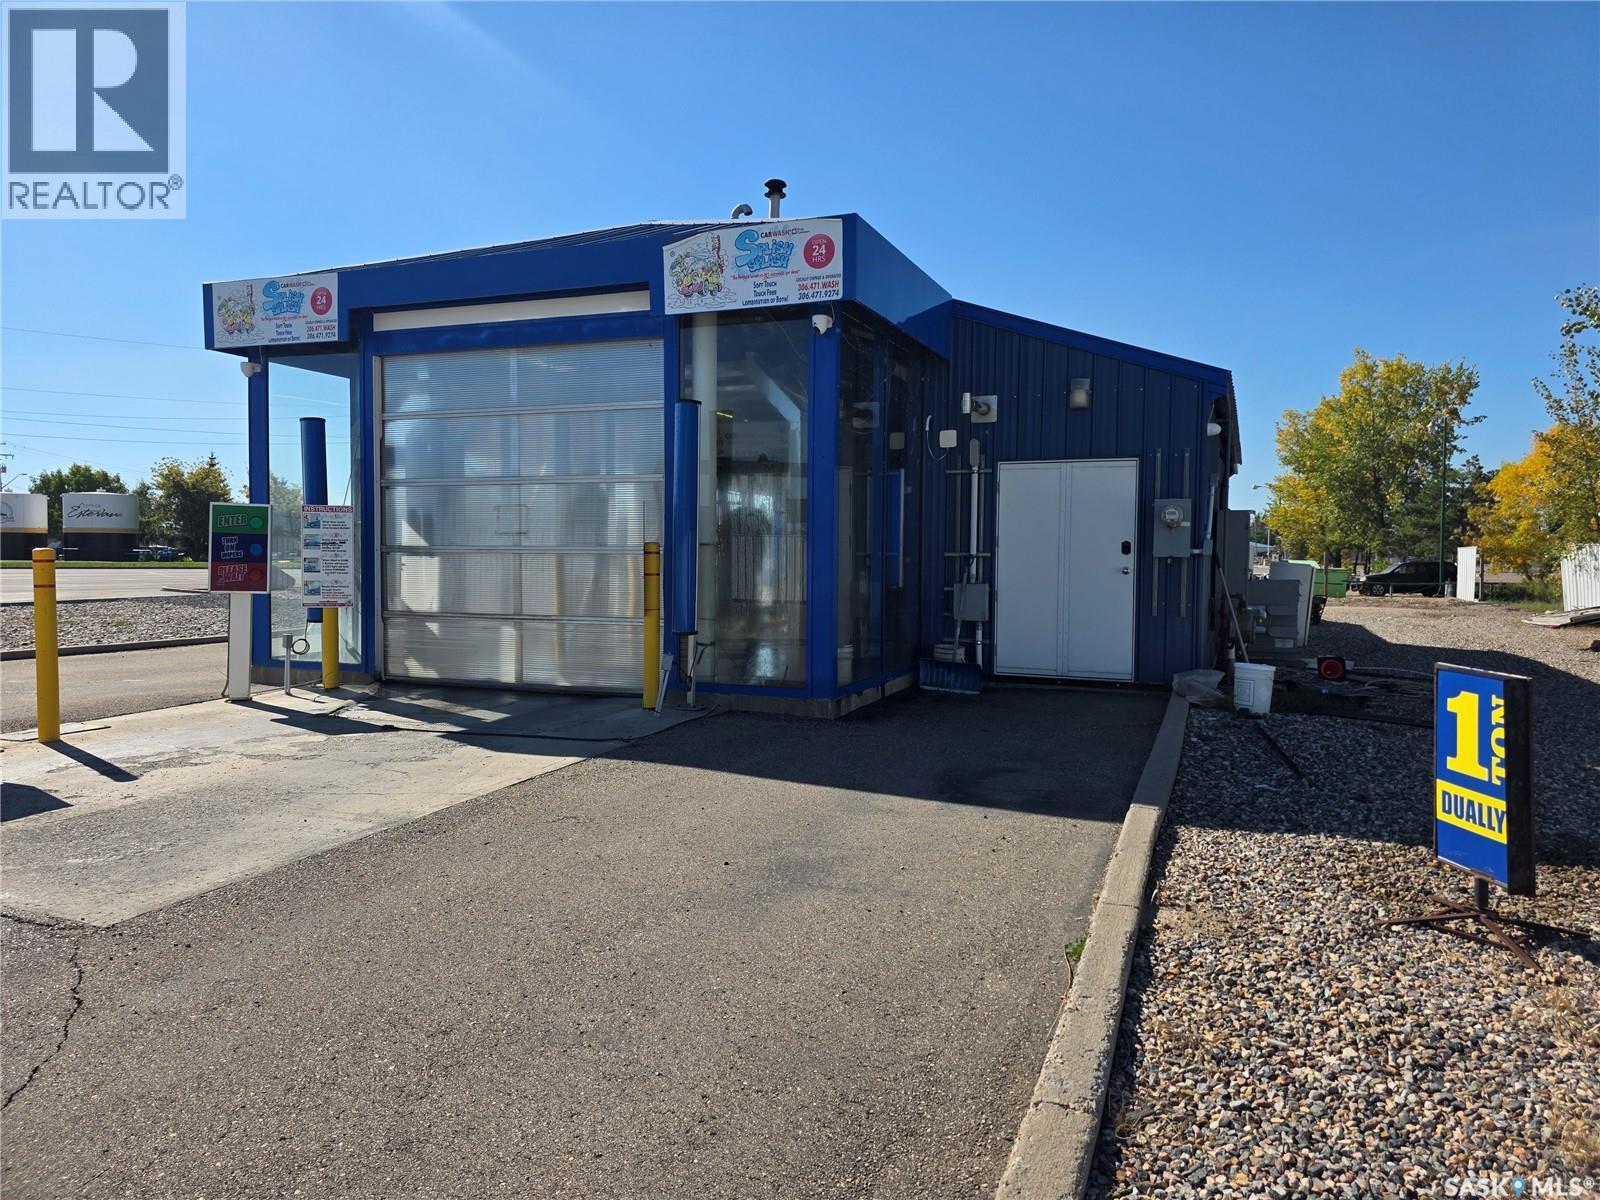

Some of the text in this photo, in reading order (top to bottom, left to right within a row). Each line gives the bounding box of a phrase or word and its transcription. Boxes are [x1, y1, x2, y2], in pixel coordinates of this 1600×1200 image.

[812, 245, 826, 256] 24
[812, 255, 826, 263] HRS
[798, 280, 840, 292] 306.471.WASH
[316, 295, 326, 305] 24
[798, 289, 840, 301] 306.471.9274
[303, 505, 353, 513] INSTRUCTIONS
[217, 514, 248, 527] ENTER
[224, 544, 236, 552] ON
[217, 564, 248, 575] PLEASE
[223, 572, 246, 583] WAIT
[1446, 690, 1489, 782] 1
[1490, 694, 1506, 786] TON
[1441, 789, 1507, 835] DUALLY
